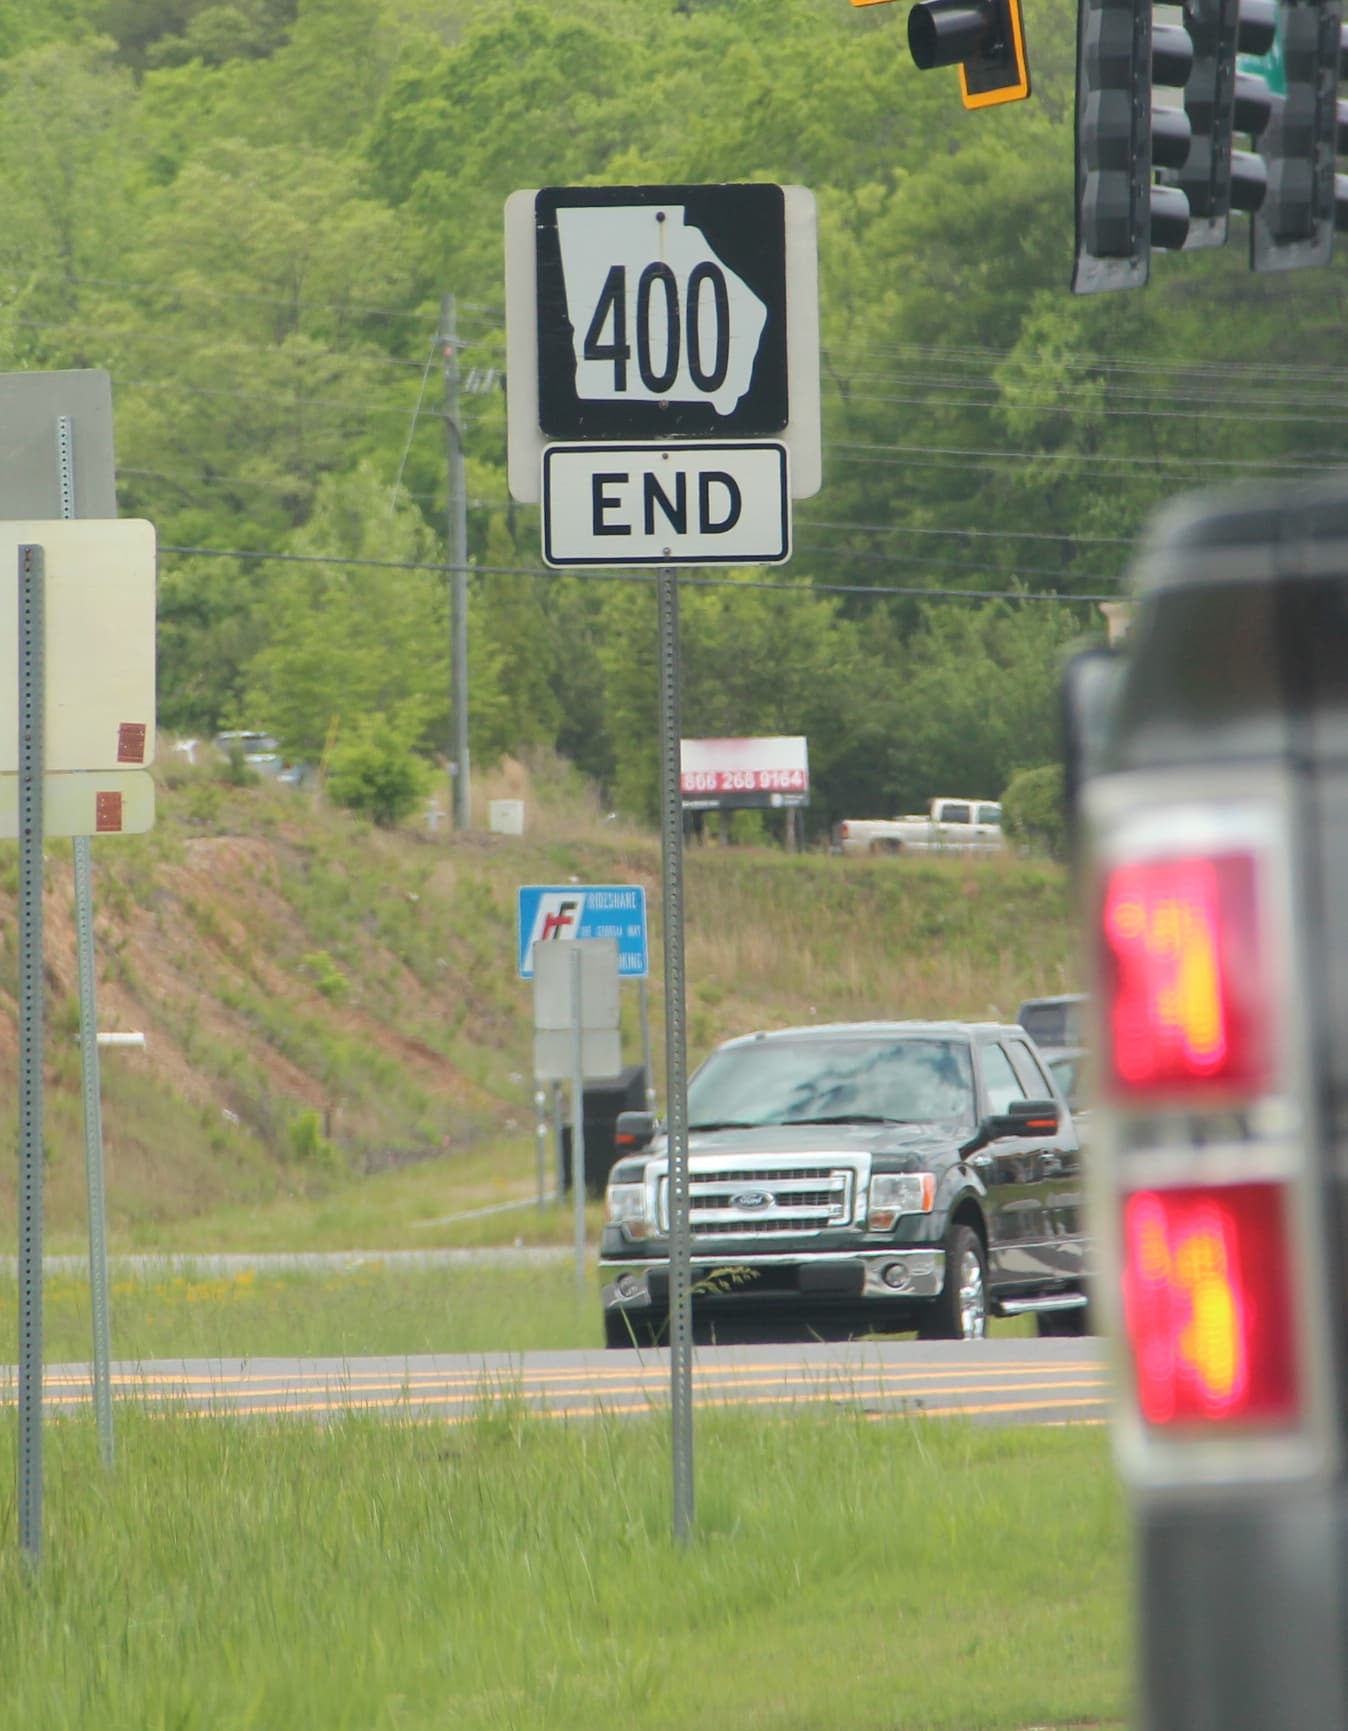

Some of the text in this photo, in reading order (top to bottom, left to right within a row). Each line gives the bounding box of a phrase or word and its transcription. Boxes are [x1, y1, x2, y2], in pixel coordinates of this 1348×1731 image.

[584, 261, 730, 394] 400
[592, 471, 742, 536] END
[722, 771, 755, 789] 268
